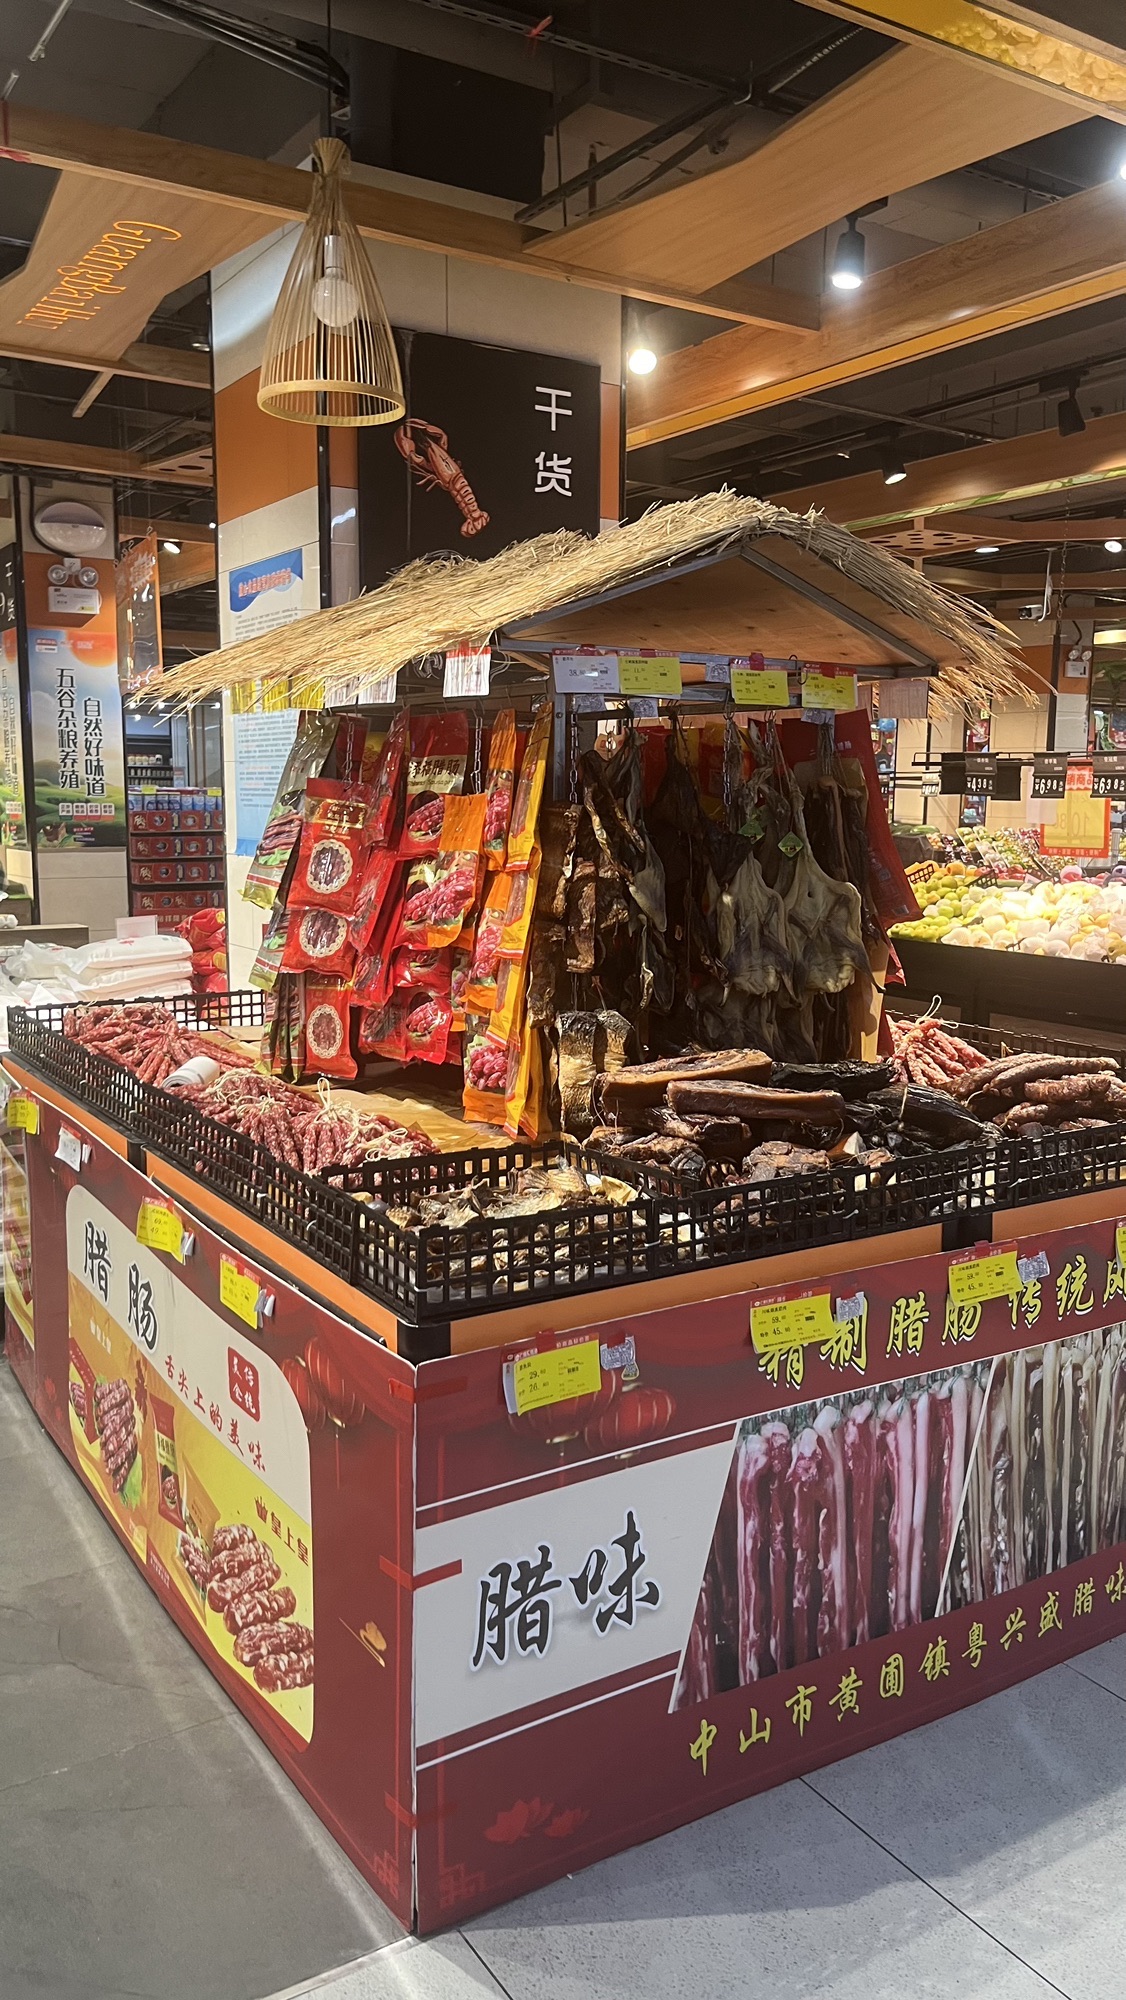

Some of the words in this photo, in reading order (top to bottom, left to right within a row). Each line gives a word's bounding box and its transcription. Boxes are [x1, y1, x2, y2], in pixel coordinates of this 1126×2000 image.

[535, 386, 572, 497] 干货
[56, 668, 80, 789] 五谷杂粮养殖
[83, 698, 106, 797] 自然好味道
[84, 1220, 157, 1351] 腊肠
[165, 1354, 266, 1473] 舌尖上的美味
[271, 1511, 309, 1567] 皇上皇
[472, 1510, 660, 1668] 腊味
[688, 1561, 1126, 1776] 中山市黄圃镇粤兴盛腊味
